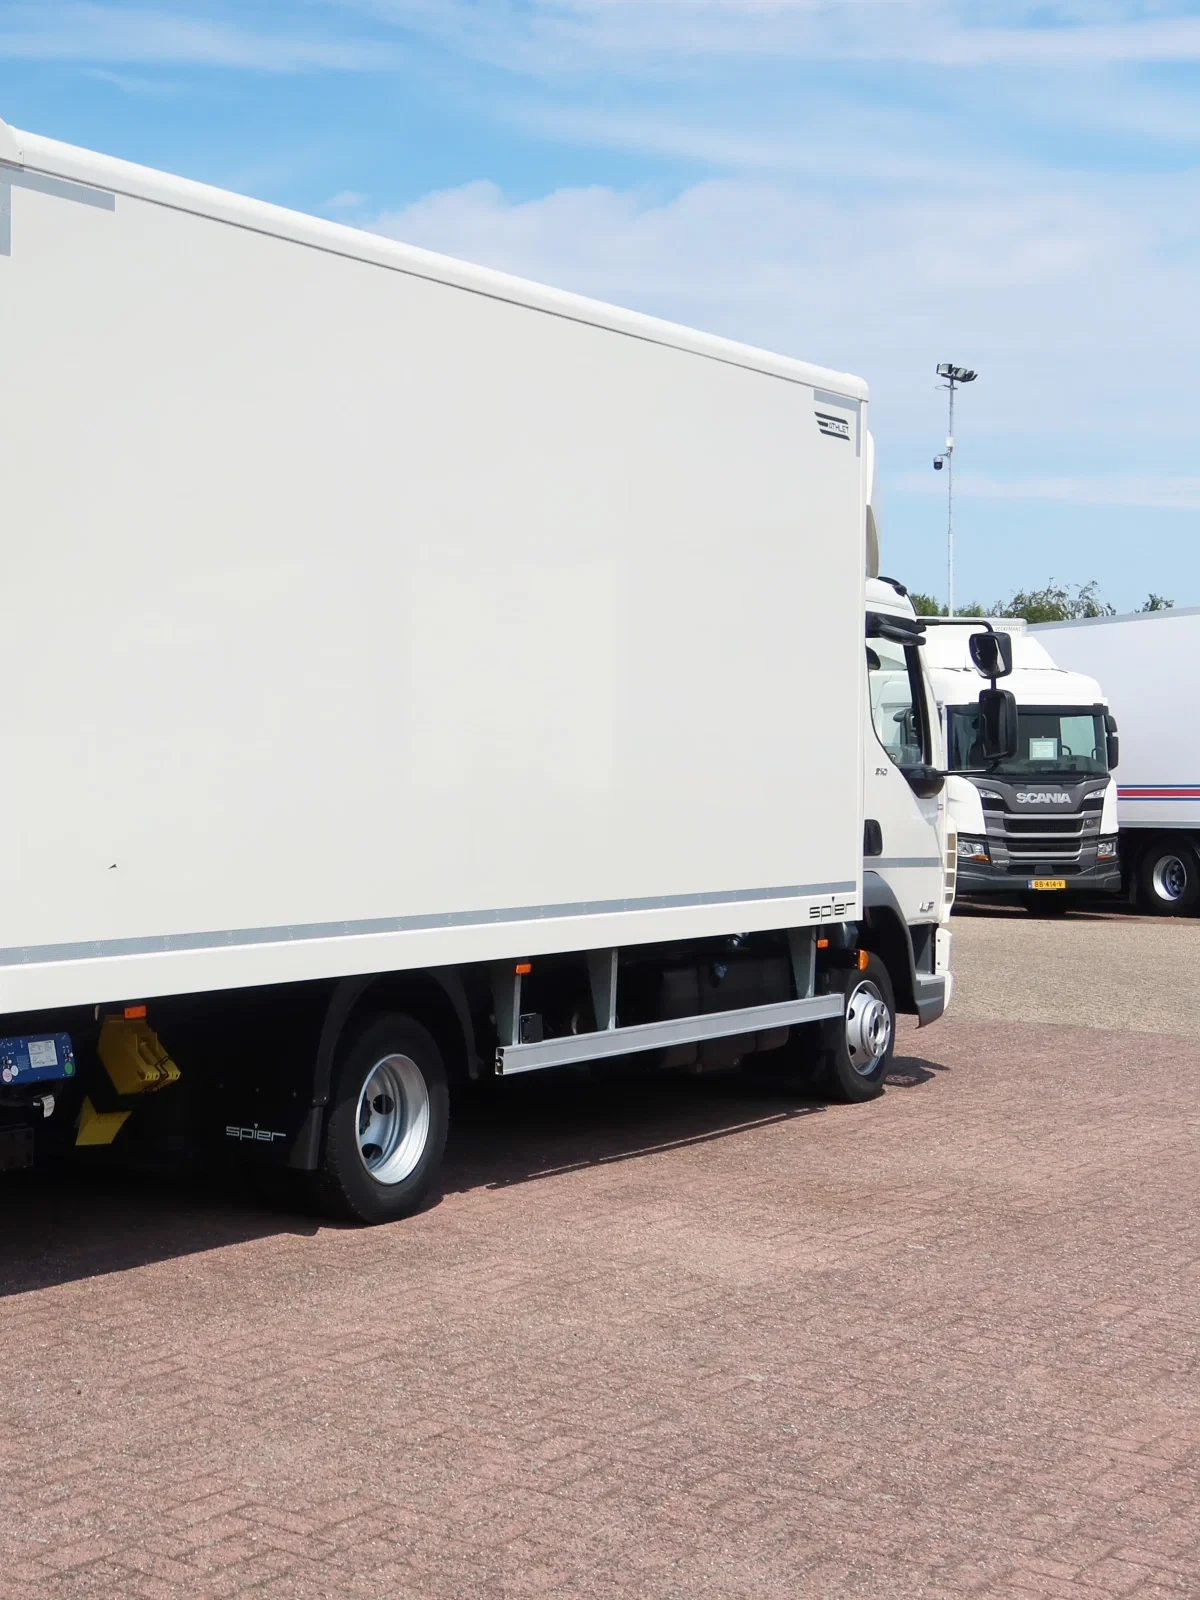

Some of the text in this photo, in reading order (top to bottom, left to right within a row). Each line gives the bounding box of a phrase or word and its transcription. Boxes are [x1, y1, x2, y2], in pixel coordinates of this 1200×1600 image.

[1016, 792, 1072, 804] SCANIA
[809, 896, 856, 922] spier
[919, 901, 935, 913] LF
[226, 1123, 286, 1141] spier
